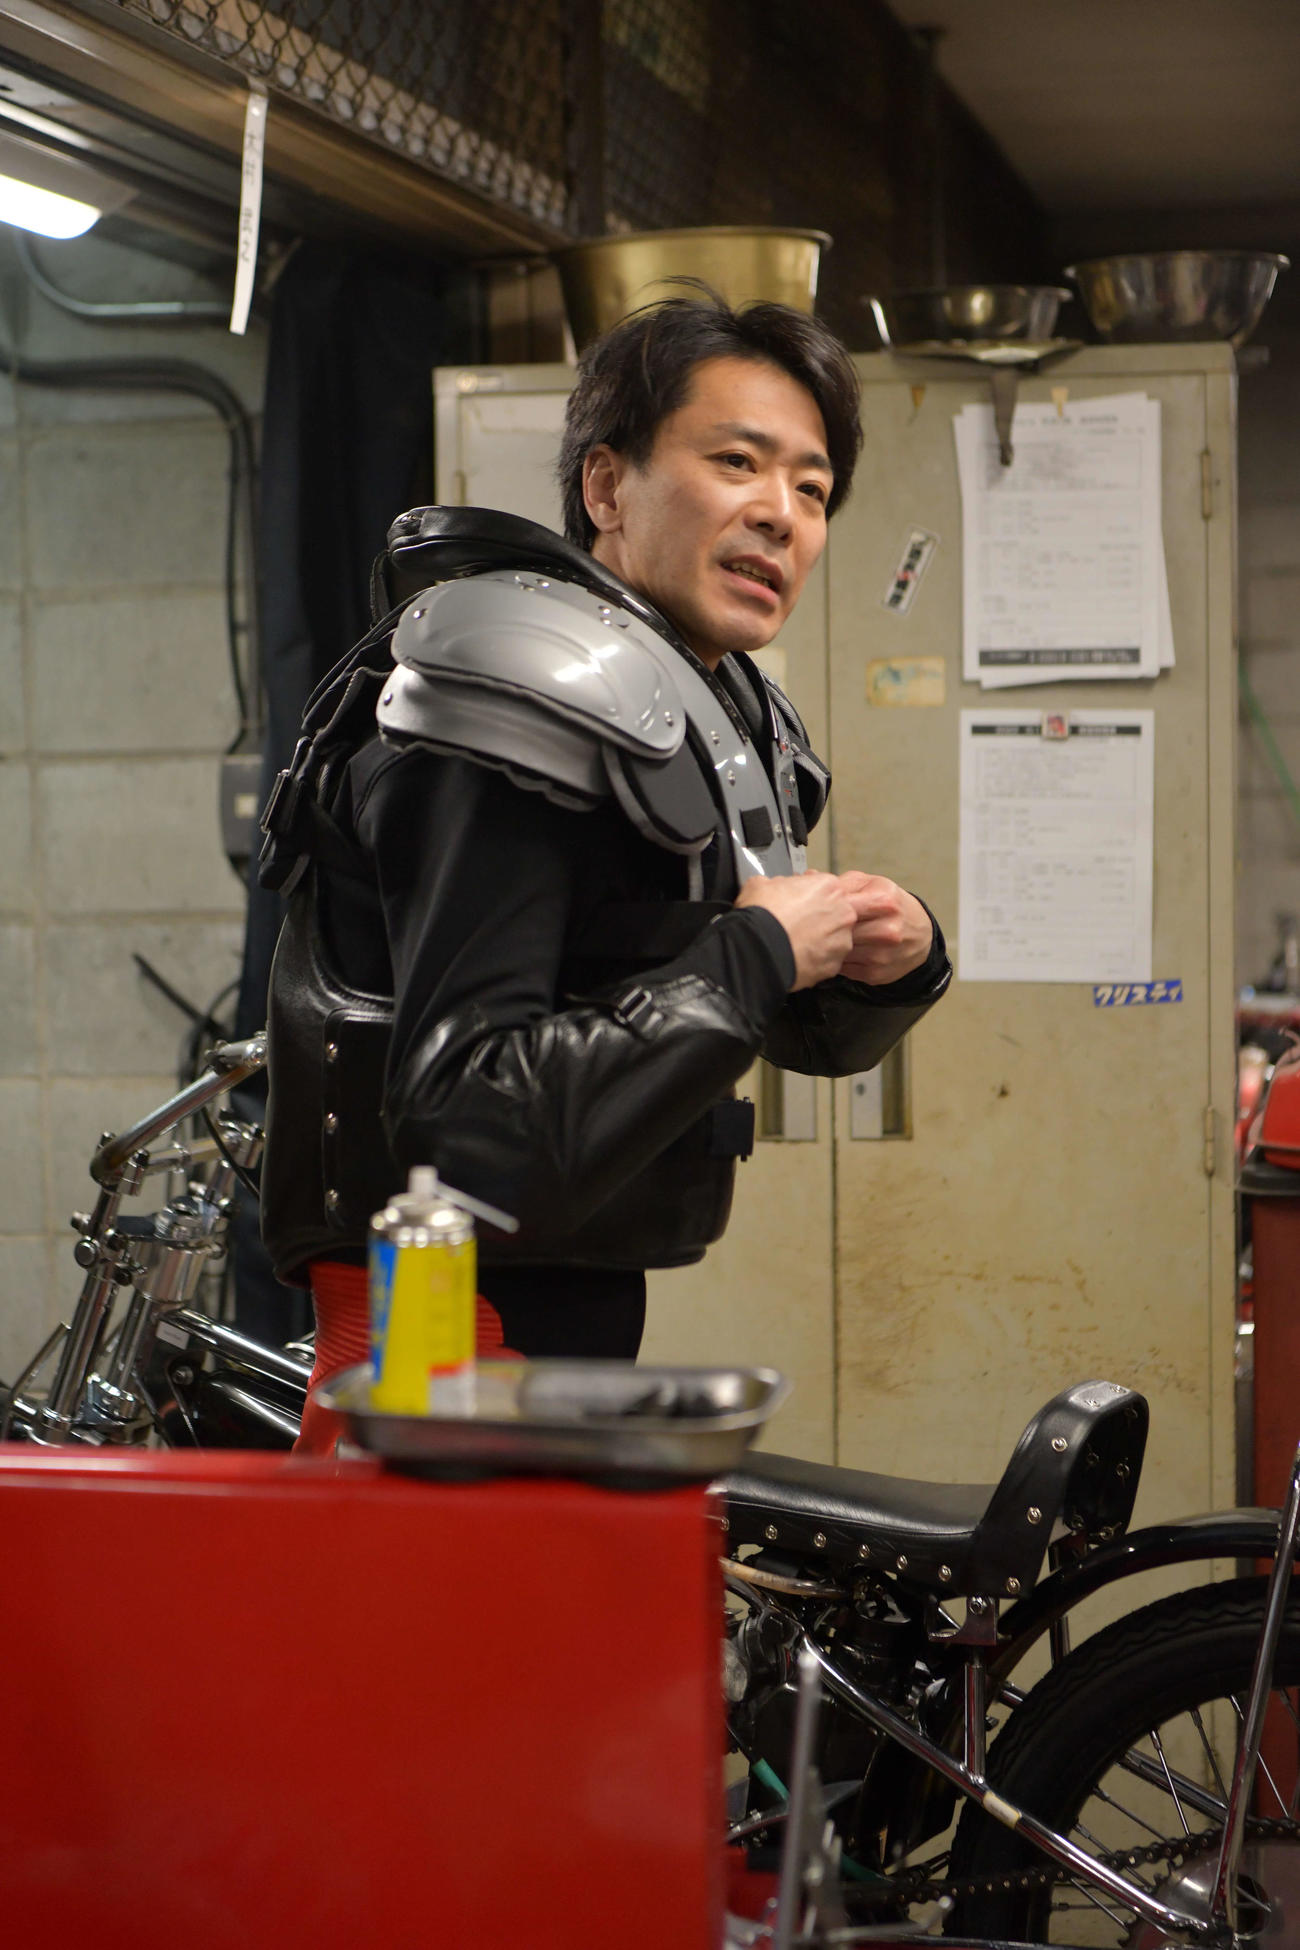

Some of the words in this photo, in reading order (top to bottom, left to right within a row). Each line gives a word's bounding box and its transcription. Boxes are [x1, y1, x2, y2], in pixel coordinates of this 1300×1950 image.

[1096, 983, 1181, 1005] クリスティ
